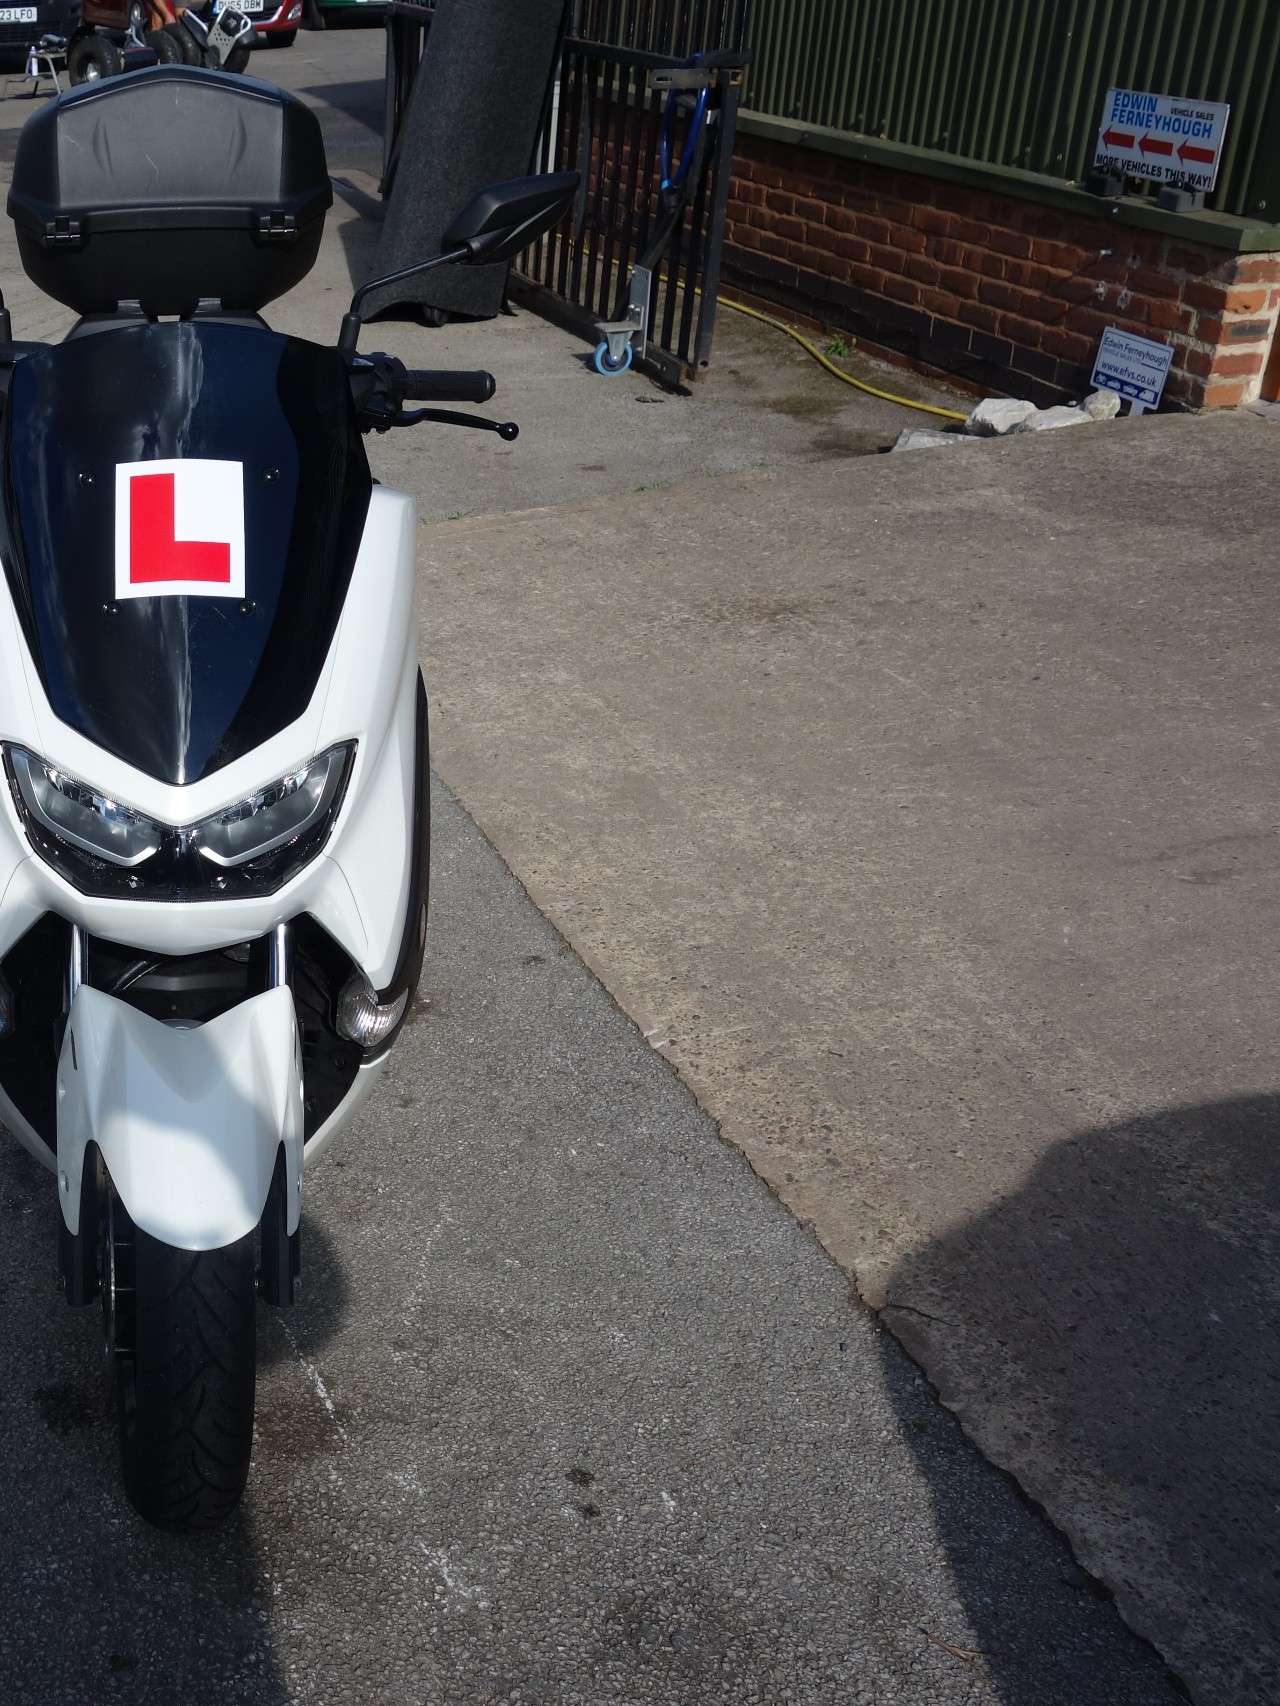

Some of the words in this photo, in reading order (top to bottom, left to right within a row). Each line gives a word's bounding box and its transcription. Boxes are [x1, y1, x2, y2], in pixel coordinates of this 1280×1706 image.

[1113, 91, 1158, 112] EDWIN
[1170, 107, 1194, 117] VEHICLE
[1195, 111, 1215, 121] SALES
[1110, 108, 1213, 139] FERNEYHOUGH
[1121, 159, 1162, 178] VEHICLES
[1165, 168, 1186, 181] THIS
[1188, 172, 1212, 188] WAY!
[1124, 343, 1169, 367] Ferneyhough
[130, 473, 230, 584] L
